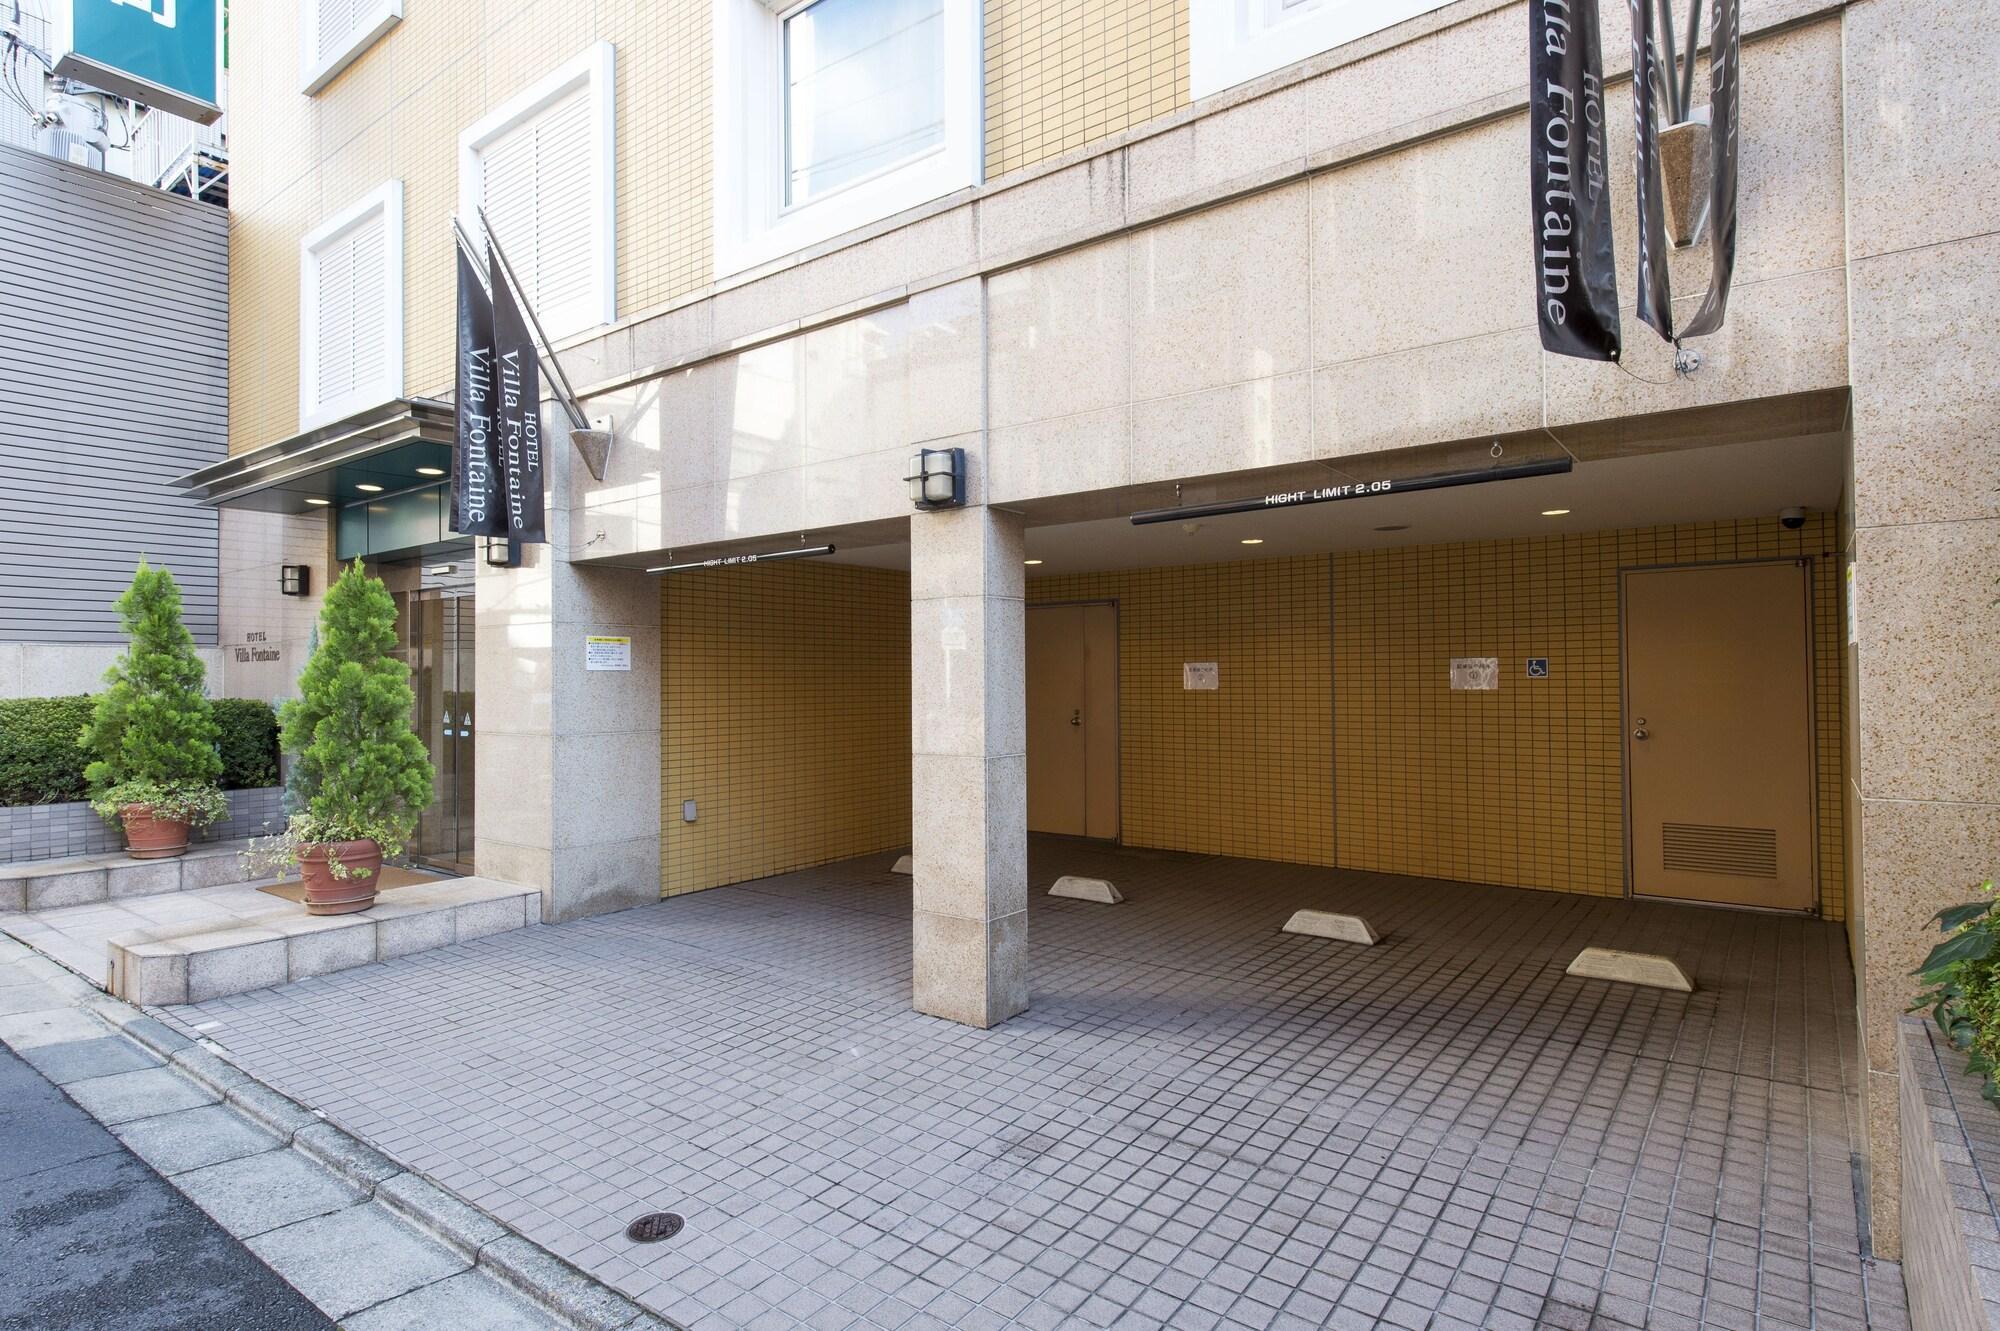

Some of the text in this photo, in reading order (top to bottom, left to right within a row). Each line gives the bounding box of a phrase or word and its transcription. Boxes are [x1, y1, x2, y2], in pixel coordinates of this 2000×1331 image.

[1583, 69, 1603, 201] HOTEL
[1543, 78, 1576, 325] Fontaine
[469, 347, 492, 522] Villa Fontaine
[501, 348, 525, 529] Villa Fontaine
[524, 411, 539, 473] HOTEL
[1265, 480, 1391, 505] HIGHT LIMIT 2.05
[235, 646, 280, 662] Villa Fontaine
[247, 632, 266, 642] HOTEL
